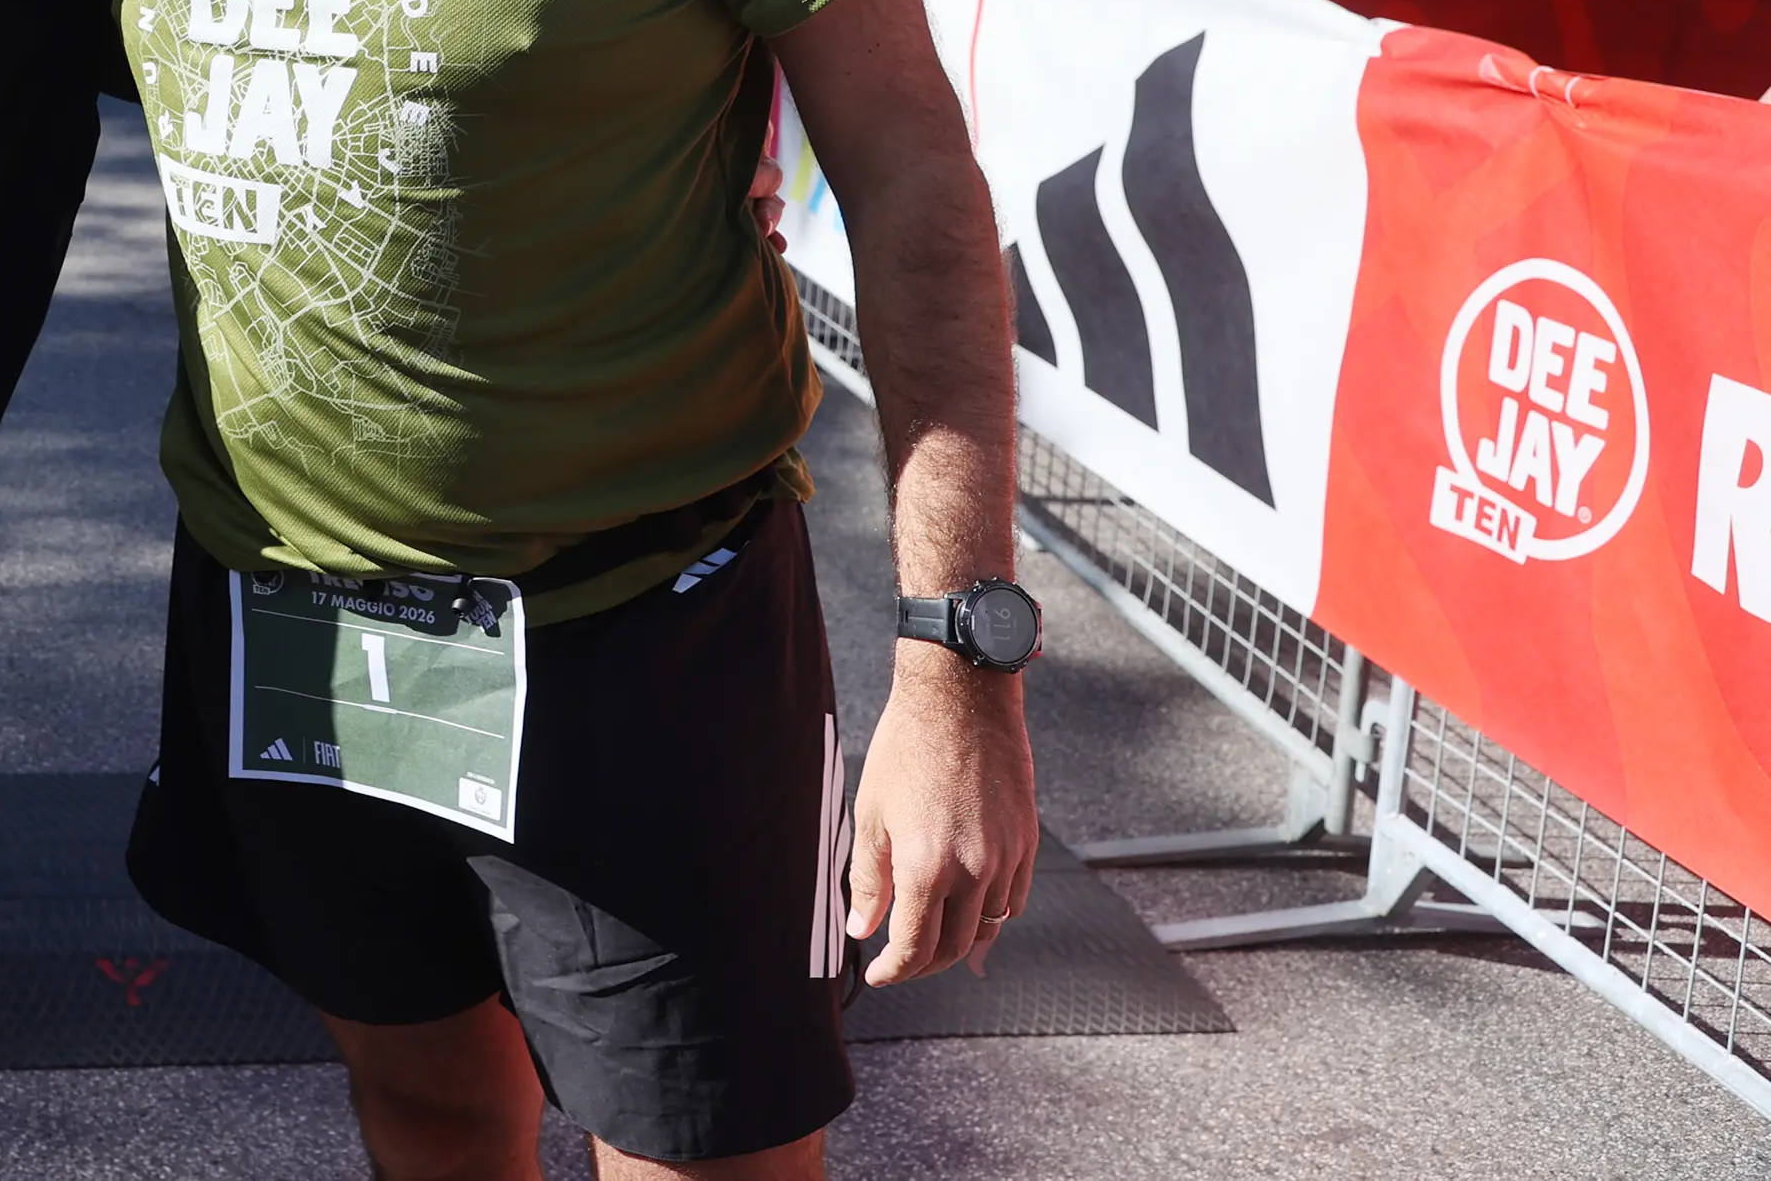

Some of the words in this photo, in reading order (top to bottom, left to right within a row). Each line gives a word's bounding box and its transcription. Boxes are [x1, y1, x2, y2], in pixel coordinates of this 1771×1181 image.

[185, 54, 358, 168] JAY
[170, 173, 259, 235] TEN
[1488, 299, 1617, 431] DEE
[1476, 396, 1606, 517] JAY
[1448, 482, 1522, 552] TEN
[311, 591, 326, 605] 17
[330, 594, 396, 617] MAGGIO
[399, 606, 436, 624] 2026
[361, 632, 390, 703] 1
[313, 740, 341, 769] FIAT
